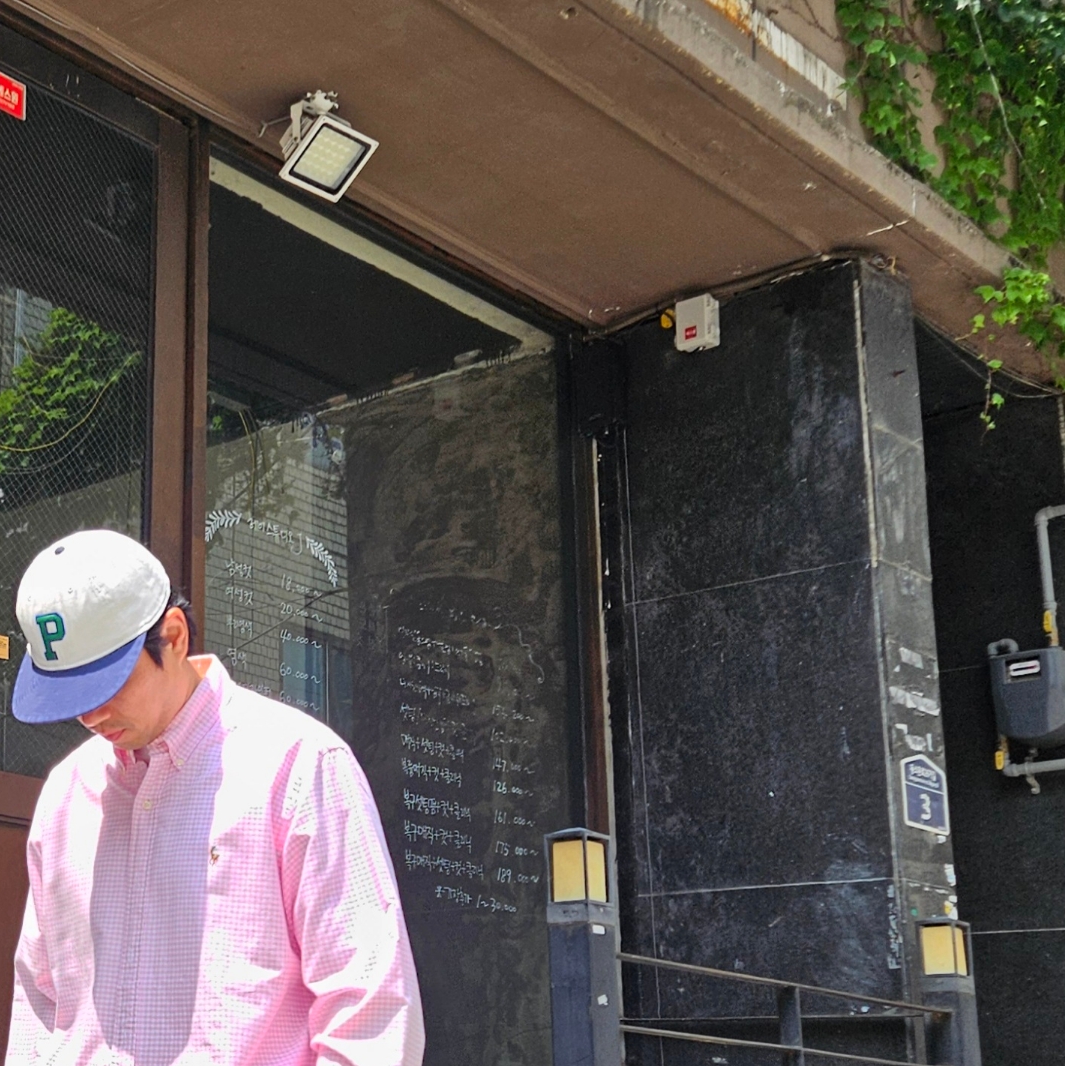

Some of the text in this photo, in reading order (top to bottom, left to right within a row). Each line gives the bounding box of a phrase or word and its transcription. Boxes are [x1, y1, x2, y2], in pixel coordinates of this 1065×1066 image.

[225, 586, 253, 606] 여성컷
[36, 612, 66, 661] P
[227, 648, 247, 670] 염색
[919, 793, 932, 821] 3
